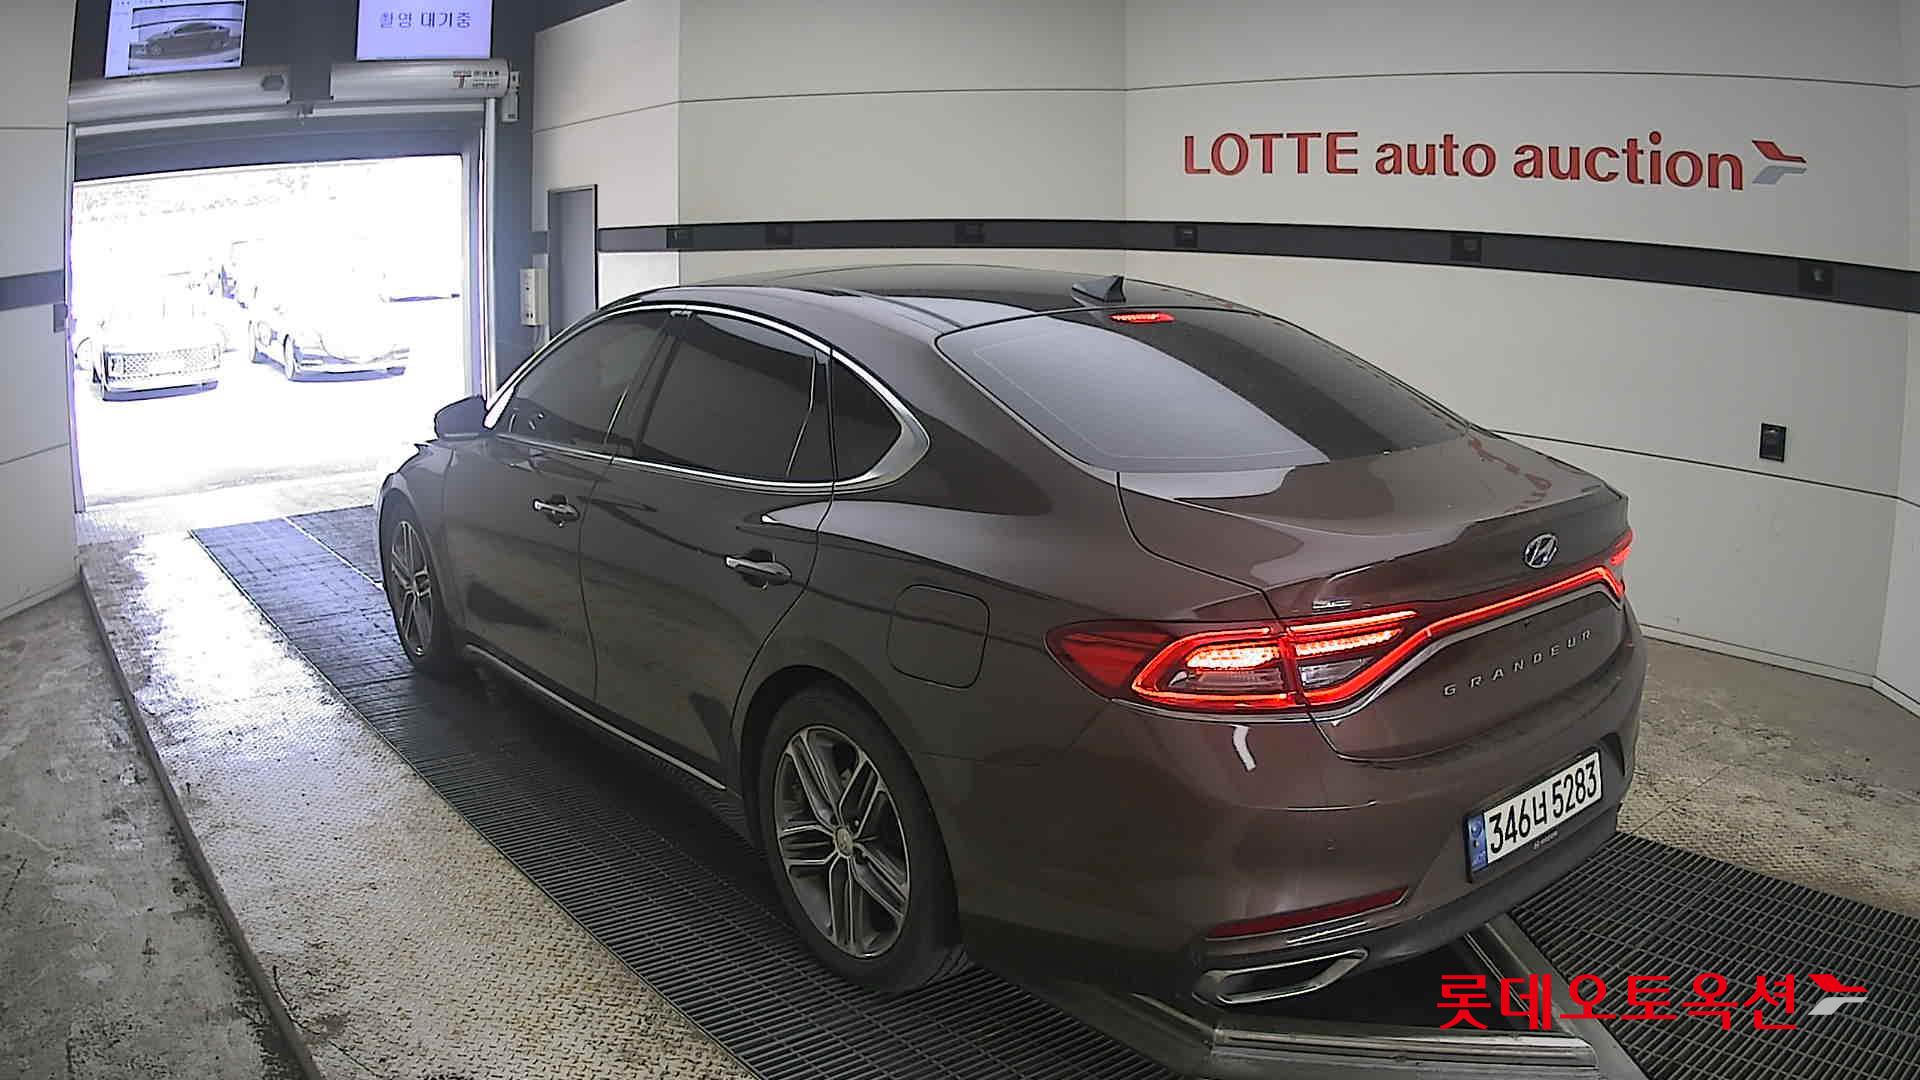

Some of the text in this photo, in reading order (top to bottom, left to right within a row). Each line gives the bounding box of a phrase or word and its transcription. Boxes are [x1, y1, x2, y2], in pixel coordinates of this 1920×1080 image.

[421, 12, 472, 28] 대기중
[1184, 131, 1744, 191] LOTTE auto auction
[1444, 630, 1592, 696] GRANDEUR
[1488, 760, 1597, 853] 346너 5283
